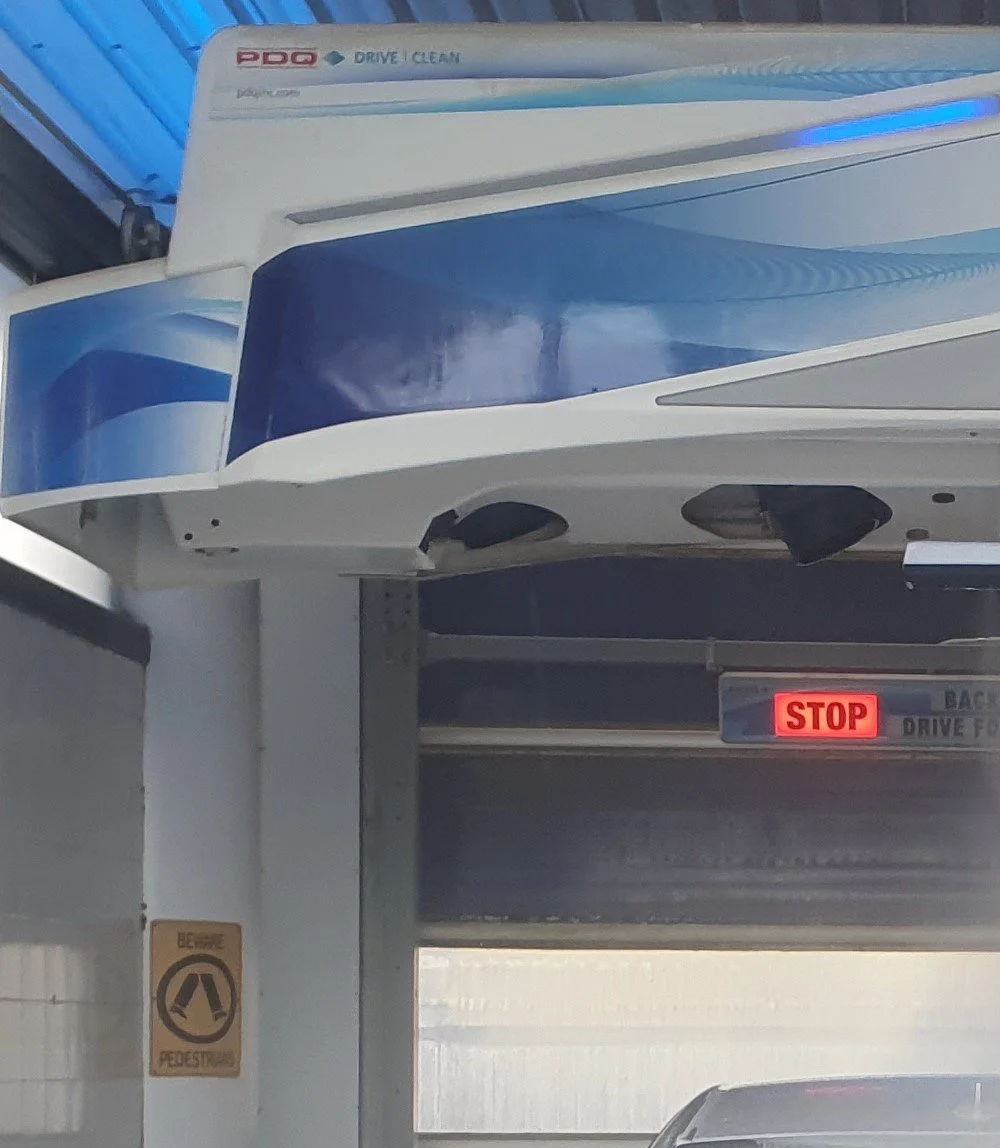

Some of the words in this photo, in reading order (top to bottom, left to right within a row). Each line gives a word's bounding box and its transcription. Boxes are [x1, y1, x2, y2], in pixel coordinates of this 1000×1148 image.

[237, 51, 317, 65] PDQ
[354, 51, 398, 64] DRIVE
[412, 51, 461, 64] CLEAN
[943, 689, 998, 709] BACK
[785, 701, 868, 731] STOP
[902, 717, 965, 738] DRIVE
